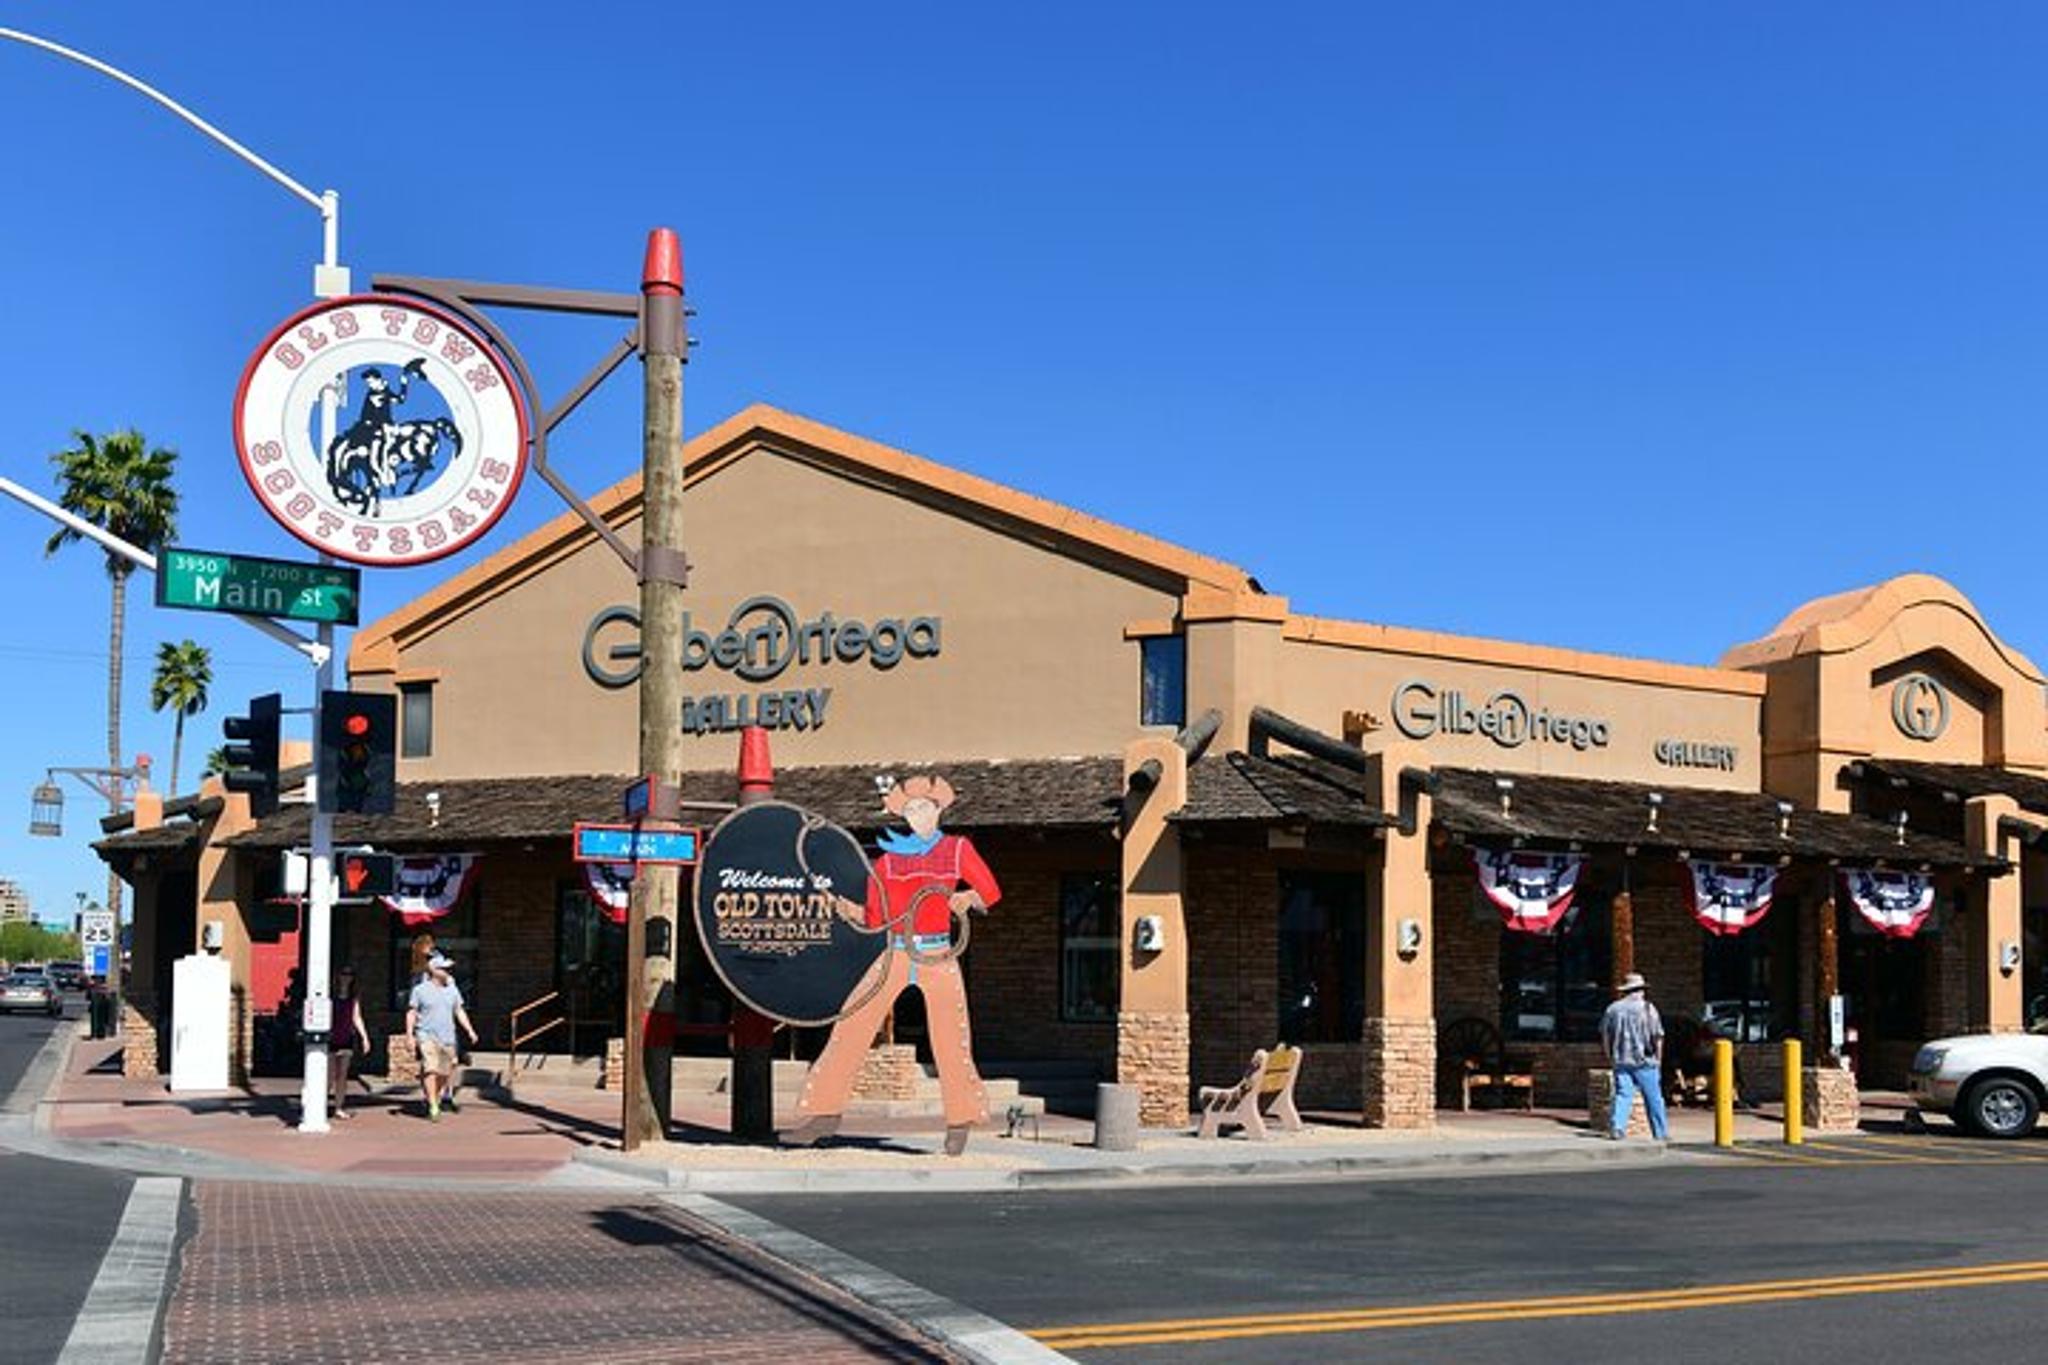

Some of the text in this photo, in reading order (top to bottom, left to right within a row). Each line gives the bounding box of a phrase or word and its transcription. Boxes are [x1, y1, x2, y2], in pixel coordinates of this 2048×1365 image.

[275, 309, 499, 393] OLD TOWN
[252, 440, 510, 555] SCOTTSDALE
[175, 557, 218, 573] 3950
[261, 566, 300, 582] 7200
[195, 576, 323, 610] Main St
[1653, 738, 1739, 772] GALLERY
[719, 868, 833, 889] Welcome to
[714, 892, 832, 919] OLD TOWN
[85, 928, 111, 942] 25
[718, 922, 832, 940] SCOTTSDALE
